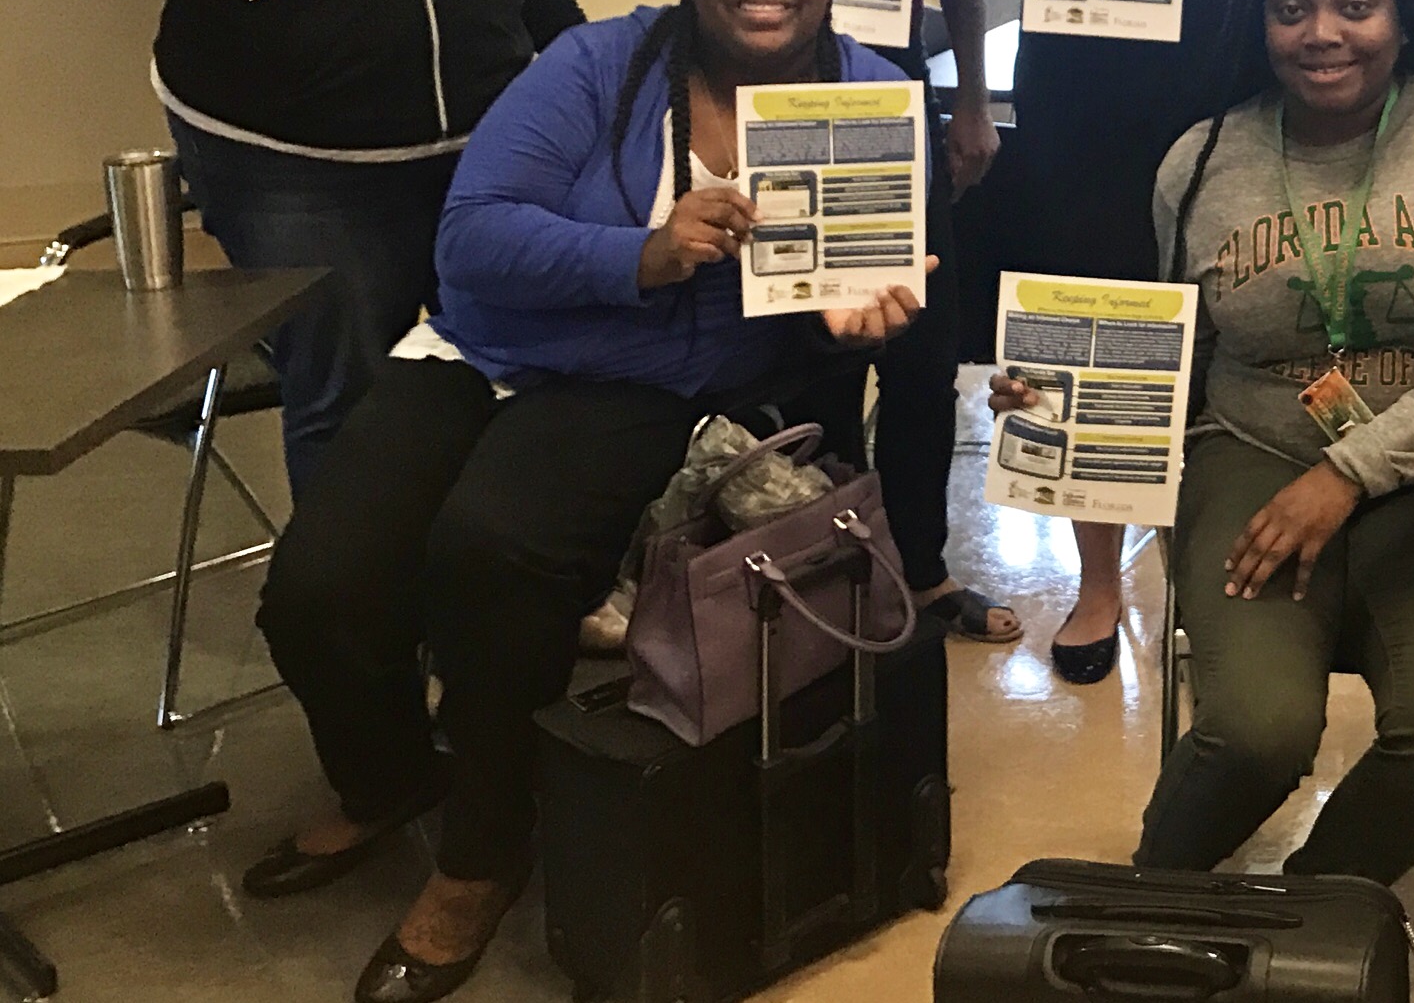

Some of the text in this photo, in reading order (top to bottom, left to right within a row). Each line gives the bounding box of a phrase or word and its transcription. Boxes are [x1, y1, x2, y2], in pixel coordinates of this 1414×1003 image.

[1214, 196, 1381, 303] FLORIDA
[1052, 289, 1153, 310] Keeping Informed
